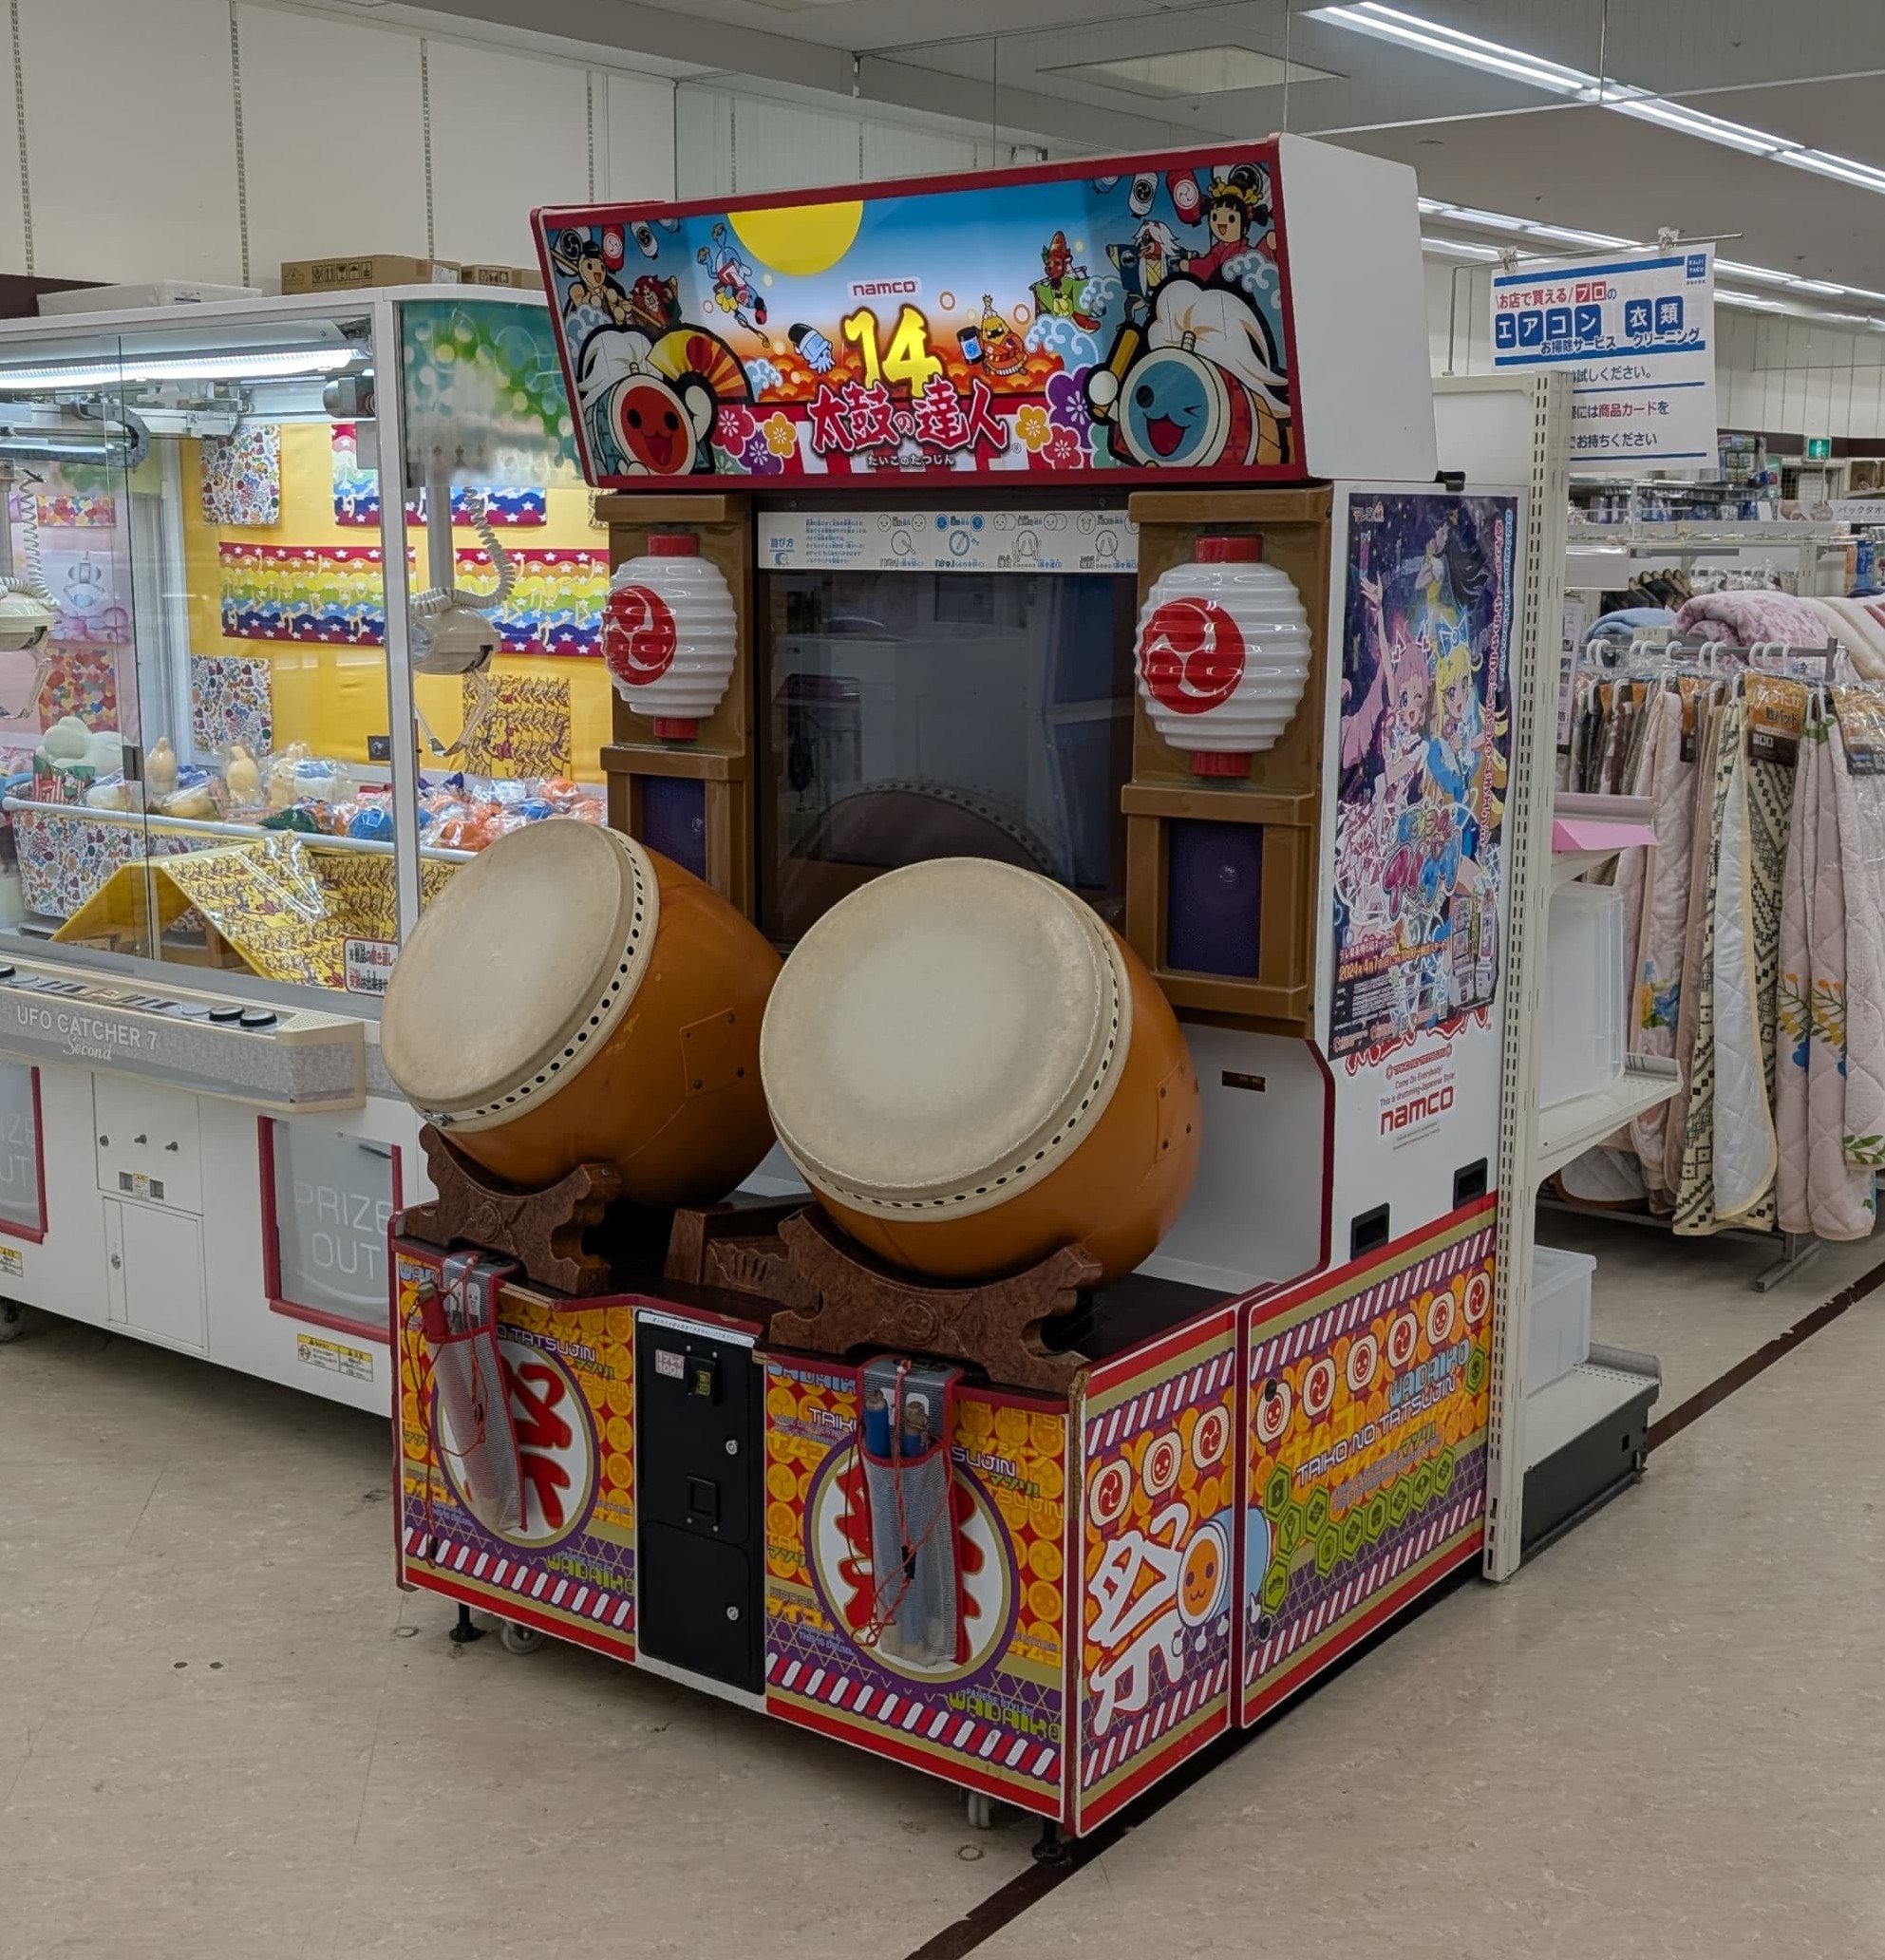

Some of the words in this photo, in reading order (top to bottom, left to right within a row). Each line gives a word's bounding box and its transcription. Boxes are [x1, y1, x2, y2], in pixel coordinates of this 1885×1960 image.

[853, 281, 916, 297] namco
[1496, 309, 1599, 344] エアコン
[1627, 299, 1681, 332] 衣類
[1540, 335, 1616, 355] お掃除サービス
[1632, 328, 1702, 348] クリーニング
[844, 308, 943, 399] 14
[807, 375, 1008, 454] 太鼓の達人
[868, 455, 955, 467] たいこのたつじん
[17, 1005, 51, 1029] UFO
[57, 1013, 141, 1048] CATCHER
[147, 1030, 159, 1050] 7
[62, 1032, 112, 1061] Second
[1380, 1085, 1454, 1136] namco
[293, 1180, 392, 1236] PRIZE
[312, 1232, 382, 1281] OUT
[512, 1328, 596, 1362] TATSUJIN
[1388, 1338, 1470, 1408] WADAIKO
[808, 1406, 858, 1433] TAIK
[1284, 1404, 1355, 1468] ナムコ
[1297, 1439, 1348, 1487] TAIKO
[1351, 1424, 1376, 1455] NO
[1379, 1377, 1456, 1436] TATSUJIN
[951, 1445, 1016, 1478] SUJIN
[1088, 1505, 1191, 1740] 祭
